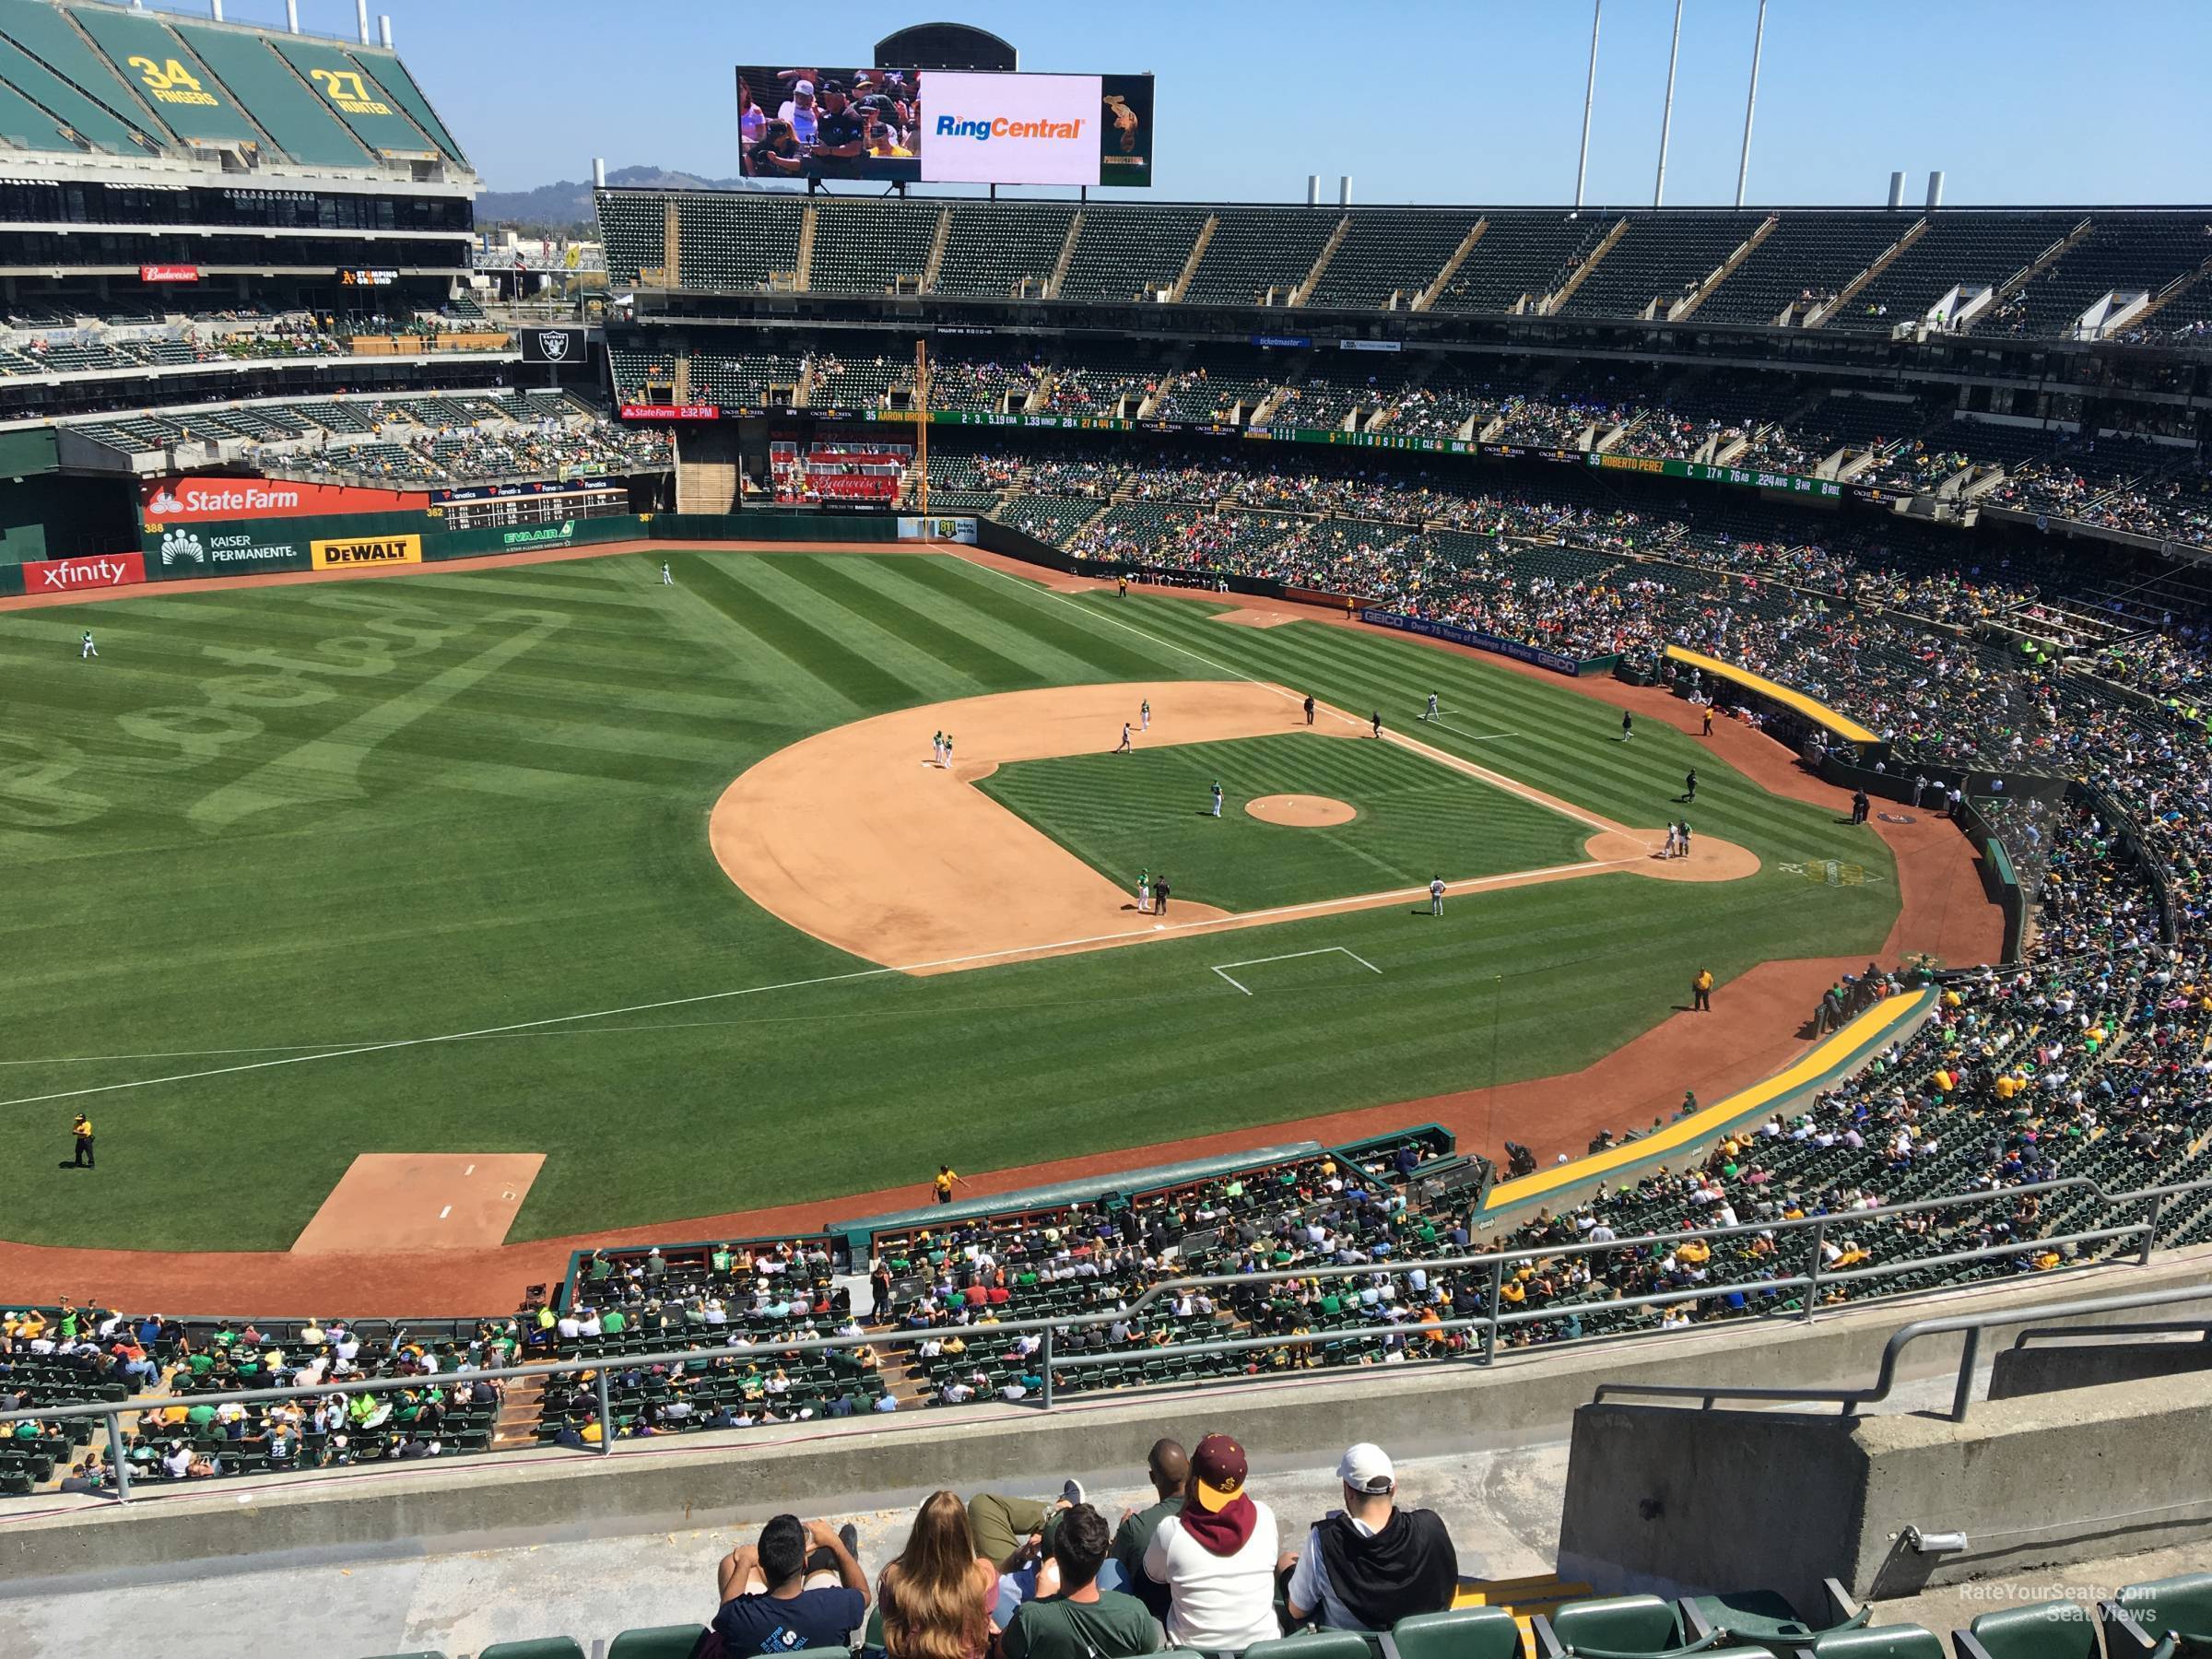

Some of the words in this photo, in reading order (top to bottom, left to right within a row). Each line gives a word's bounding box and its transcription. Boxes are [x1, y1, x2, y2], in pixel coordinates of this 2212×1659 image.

[128, 57, 202, 91] 34
[311, 69, 371, 101] 27
[152, 89, 219, 106] FINGERS
[336, 100, 393, 116] HUNTER
[936, 116, 1081, 141] RingCentral
[144, 267, 195, 281] Budweiser
[1260, 338, 1300, 347] ticketmaster
[681, 407, 698, 417] 2:32
[700, 408, 712, 417] PM
[866, 411, 876, 421] 35
[878, 411, 903, 421] AARON
[988, 415, 1005, 425] 5.19
[1006, 416, 1017, 424] ERA
[1024, 416, 1040, 426] 1.33
[1041, 418, 1057, 426] WHIP
[1062, 418, 1072, 428] 28
[1082, 418, 1091, 429] 27
[1423, 439, 1434, 449] CLE
[1452, 441, 1465, 452] OAK
[1589, 453, 1600, 465] 55
[1601, 456, 1638, 470] ROBERTO
[1638, 459, 1664, 473] PEREZ
[1687, 465, 1694, 476] C
[1706, 467, 1717, 479] 17
[1730, 469, 1740, 482] 76
[1740, 473, 1750, 482] AB
[1755, 474, 1775, 487] .224
[1775, 477, 1788, 488] AVG
[1794, 478, 1801, 490] 3
[1801, 481, 1811, 491] HR
[1828, 485, 1840, 496] RBI
[812, 475, 882, 489] Budweise
[427, 508, 443, 517] 362
[639, 513, 653, 522] 367
[144, 524, 164, 533] 388
[940, 520, 955, 532] 811
[210, 535, 251, 548] KAISER
[212, 547, 293, 562] PERMANENTE
[43, 559, 126, 589] xfinity
[1364, 611, 1403, 627] GEICO
[1411, 621, 1429, 632] Over
[1431, 625, 1441, 635] 75
[1443, 629, 1461, 640] Years
[1463, 633, 1471, 642] of
[1508, 645, 1532, 658] Service
[1537, 653, 1576, 673] GEICO
[15, 1345, 23, 1354] 9
[271, 1446, 286, 1457] 22
